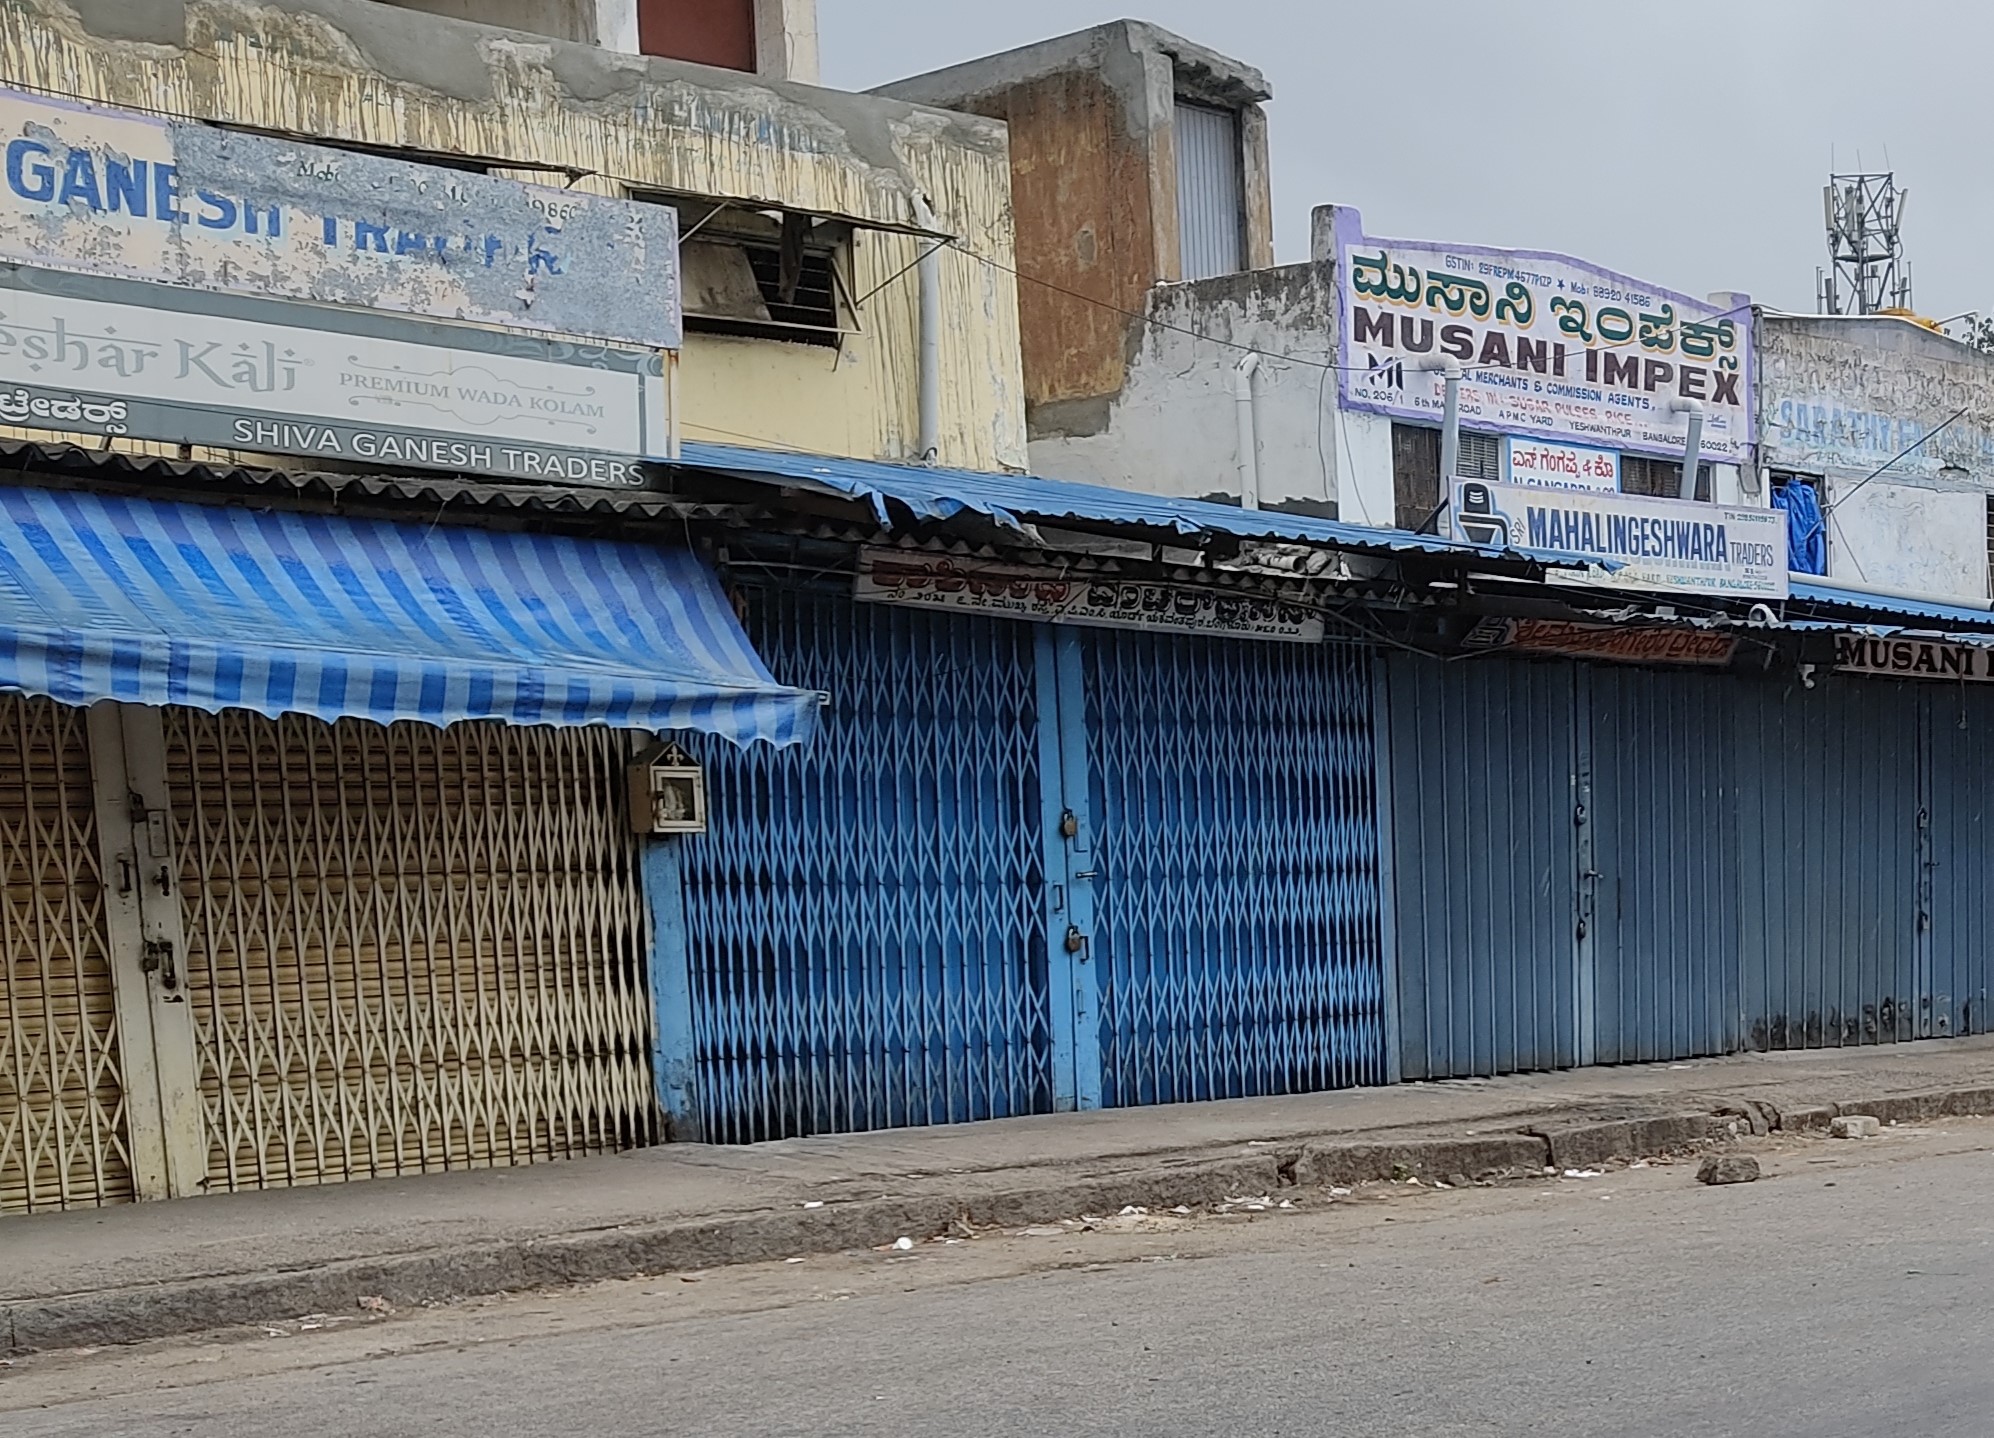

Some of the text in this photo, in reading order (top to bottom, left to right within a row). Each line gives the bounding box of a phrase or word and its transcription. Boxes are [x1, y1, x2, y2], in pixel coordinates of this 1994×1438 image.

[1352, 250, 1533, 325] ಮುಸಾನಿ
[1353, 305, 1740, 406] MUSANI IMPEX
[339, 372, 605, 419] PREMIUM WADA KOLAM
[1475, 368, 1529, 391] MERCHANTS
[1533, 379, 1543, 393] &
[1546, 382, 1602, 402] COMMISSION
[1530, 415, 1554, 427] YARD
[232, 418, 646, 487] SHIVA GANESH TRADERS
[1509, 516, 1527, 545] SRI
[1526, 506, 1728, 564] MAHALINGESHWARA
[1729, 541, 1774, 567] TRADERS
[1835, 636, 1975, 677] MUSANI
